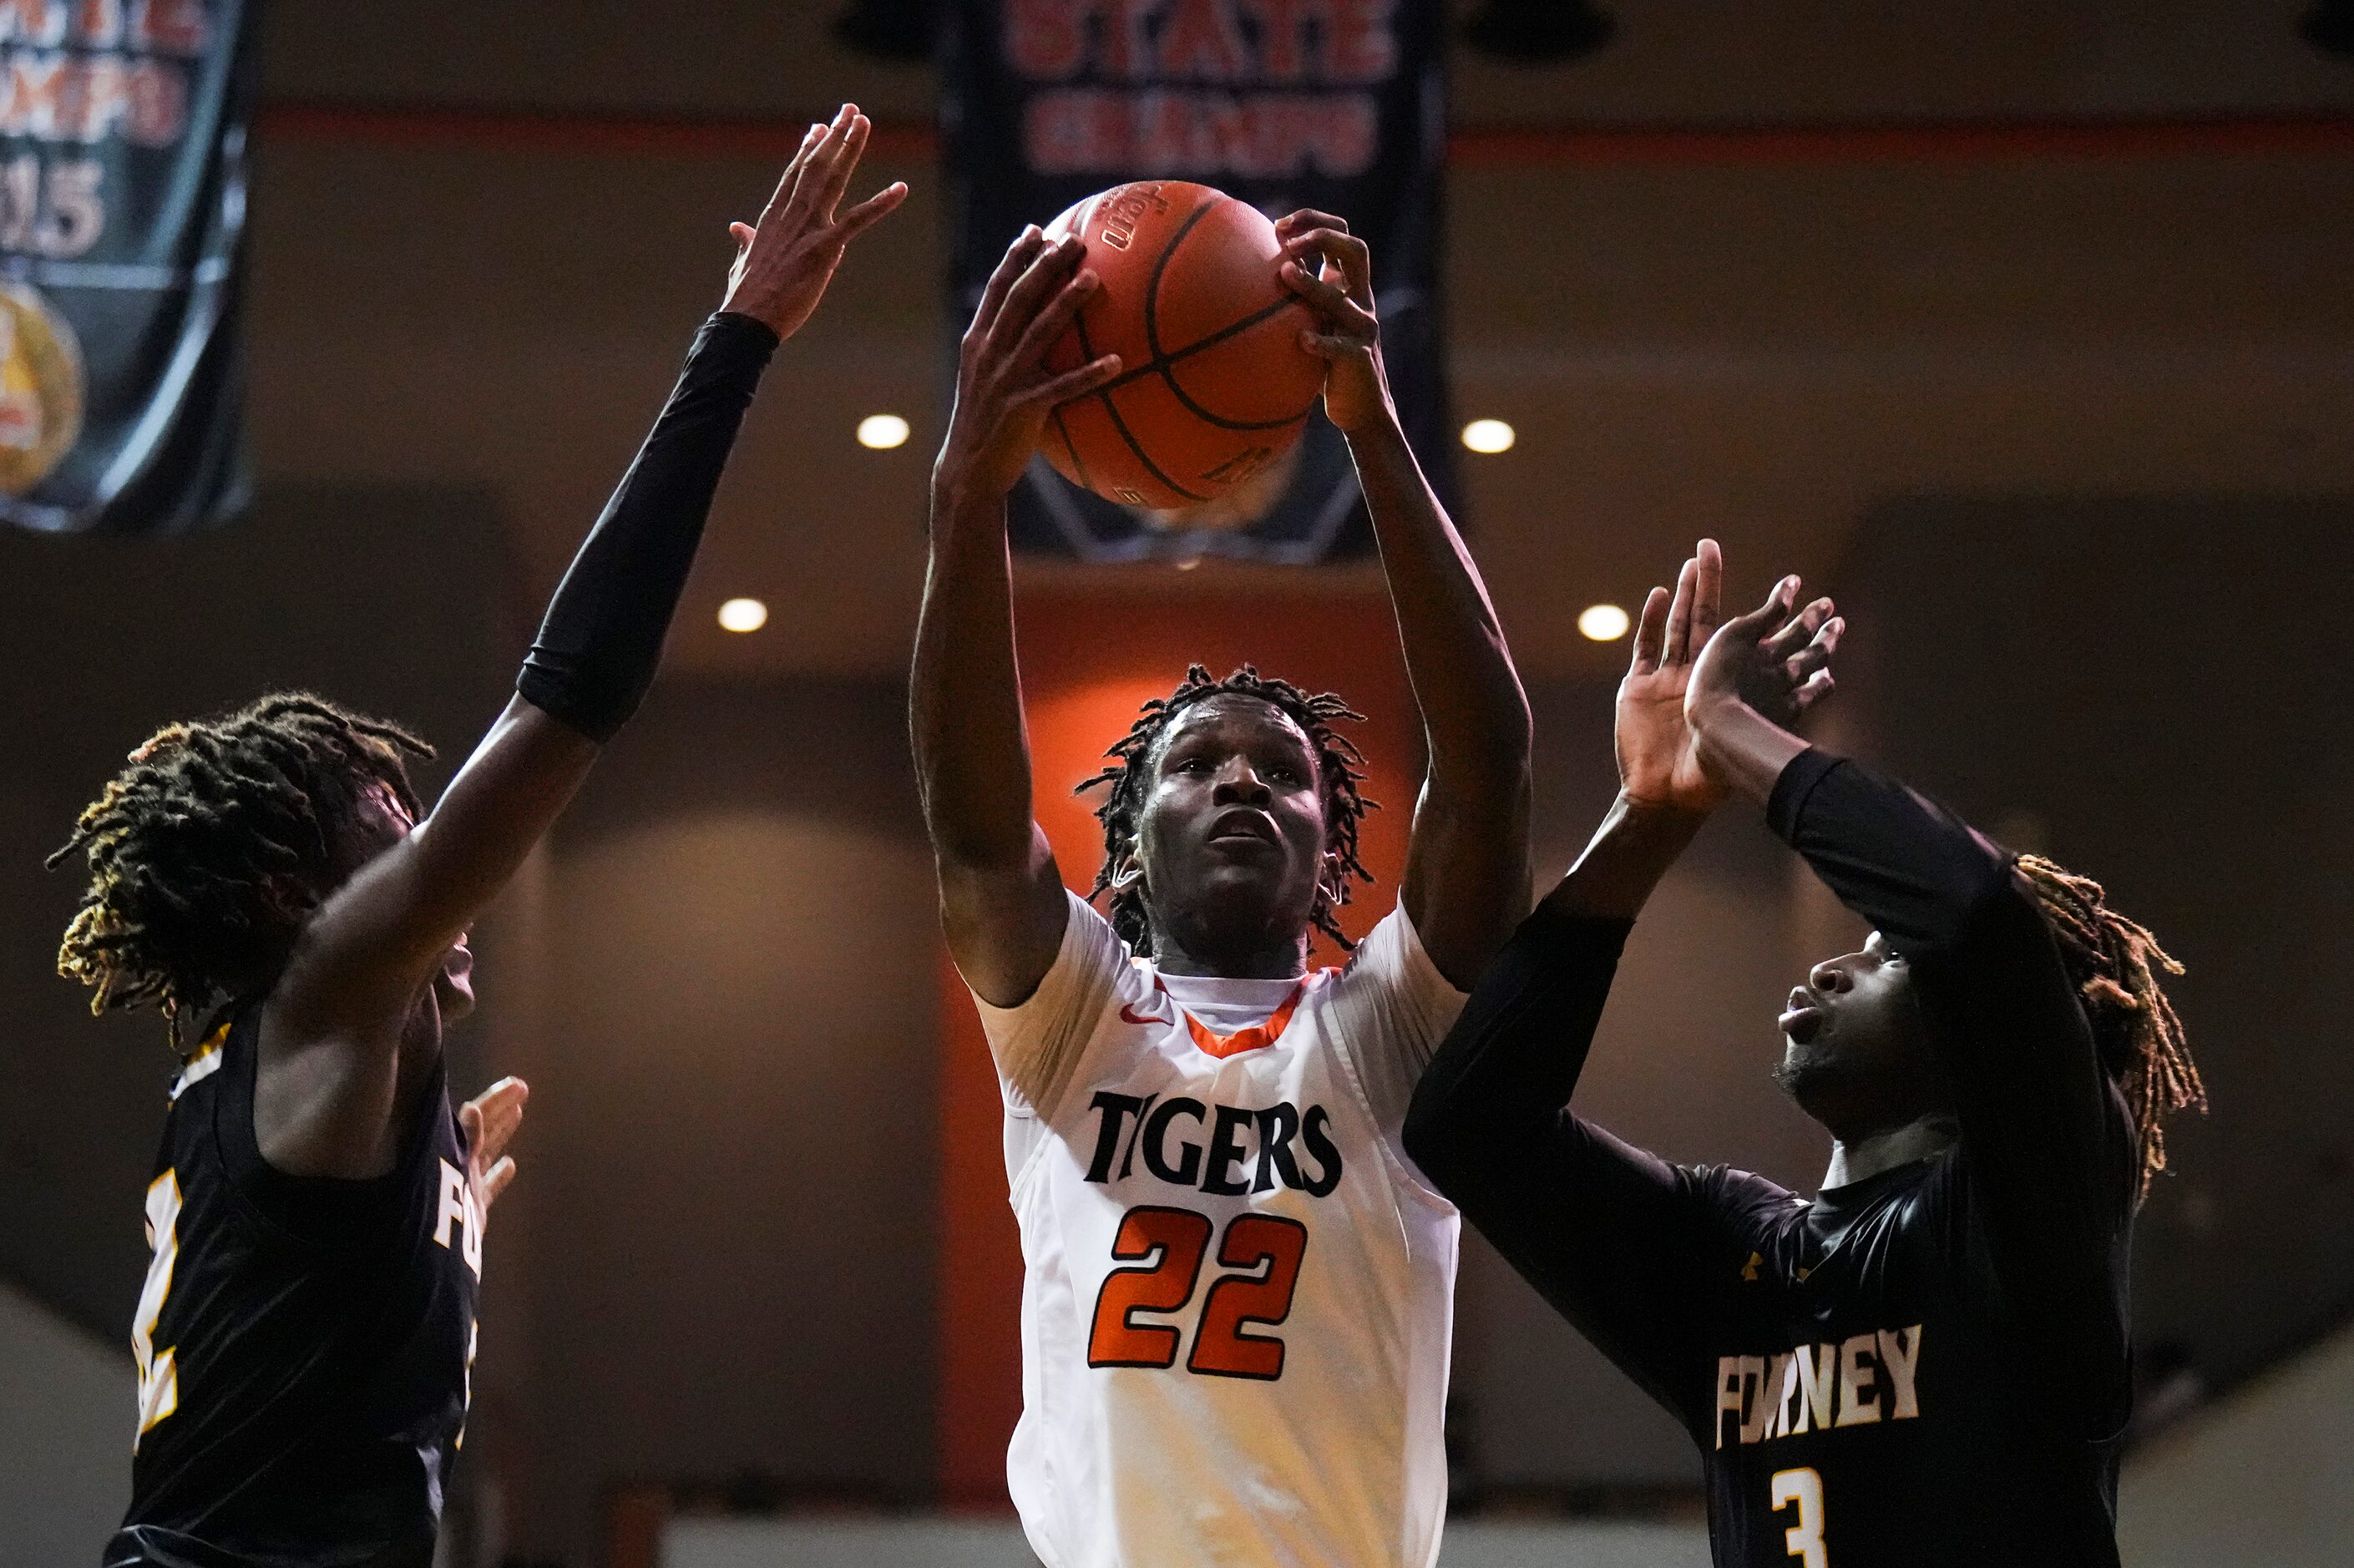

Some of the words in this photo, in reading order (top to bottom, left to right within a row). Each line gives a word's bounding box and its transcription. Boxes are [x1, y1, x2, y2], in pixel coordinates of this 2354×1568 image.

[0, 153, 104, 257] 15
[1082, 1090, 1343, 1198] TIGERS
[1087, 1205, 1308, 1381] 22
[1771, 1466, 1828, 1568] 3
